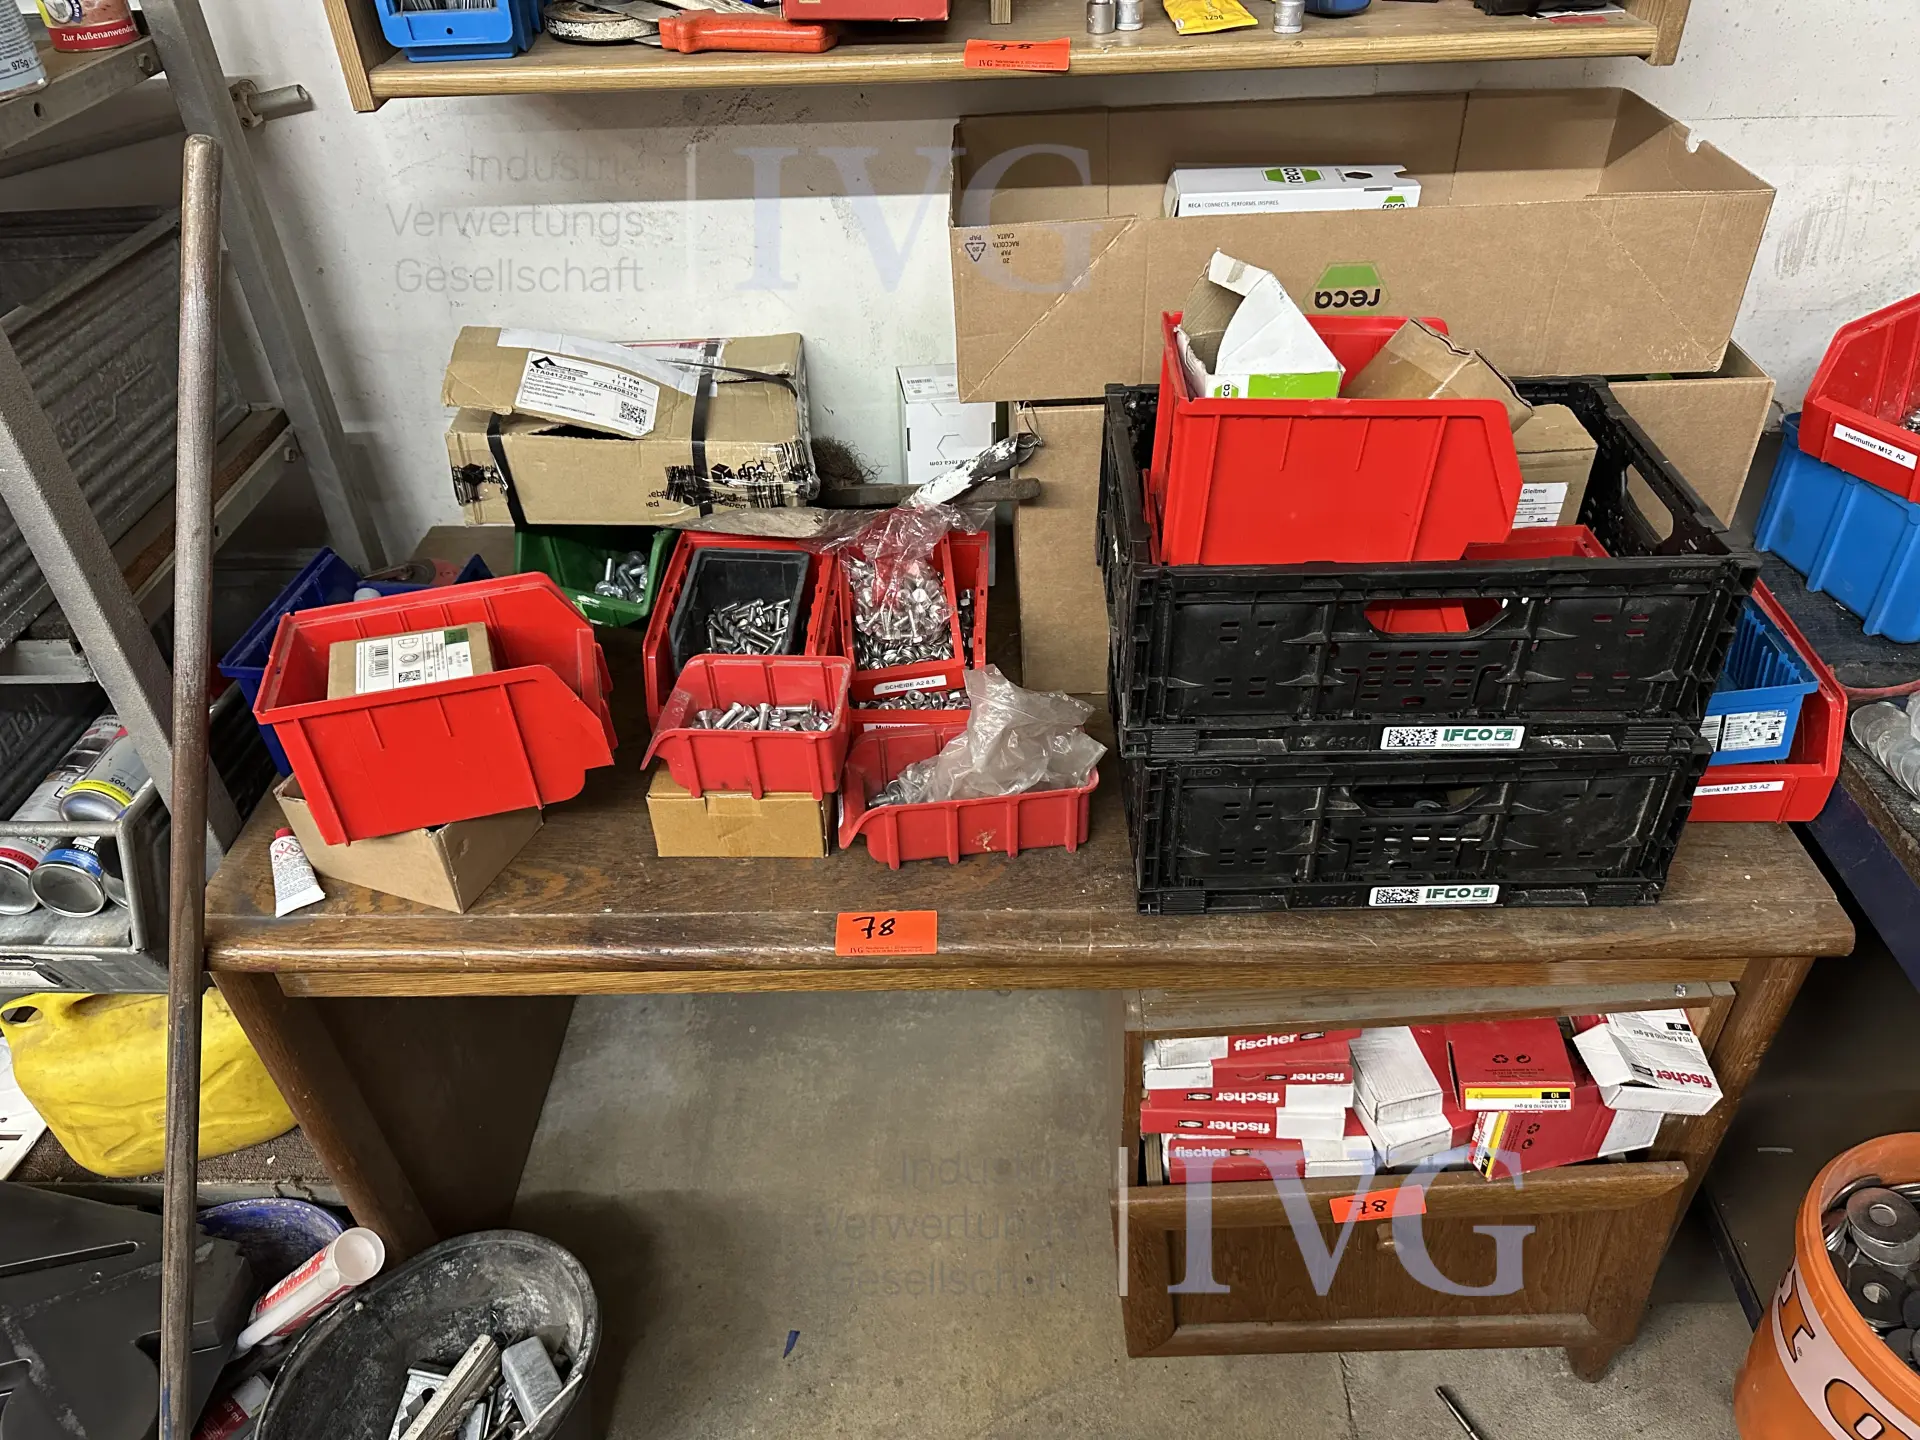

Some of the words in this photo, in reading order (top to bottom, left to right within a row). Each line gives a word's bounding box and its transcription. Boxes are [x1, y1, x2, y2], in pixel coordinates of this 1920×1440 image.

[62, 33, 75, 41] Zur
[11, 59, 30, 71] 975g
[1282, 168, 1303, 184] reca
[1314, 288, 1381, 309] reca
[1844, 432, 1876, 449] Hutmutter
[1878, 446, 1893, 456] M12
[1896, 454, 1906, 462] A2
[884, 682, 914, 690] SCHEIBE
[1443, 728, 1493, 741] IFCO
[109, 777, 126, 788] 500
[1426, 888, 1471, 899] IFCO
[852, 916, 896, 940] 78
[1234, 1034, 1297, 1050] fischer
[1290, 1072, 1345, 1082] fischer
[1656, 1068, 1713, 1088] fischer
[1216, 1092, 1280, 1104] fischer
[1207, 1120, 1271, 1134] fischer
[1174, 1146, 1228, 1158] fischer
[1347, 1199, 1388, 1215] 78
